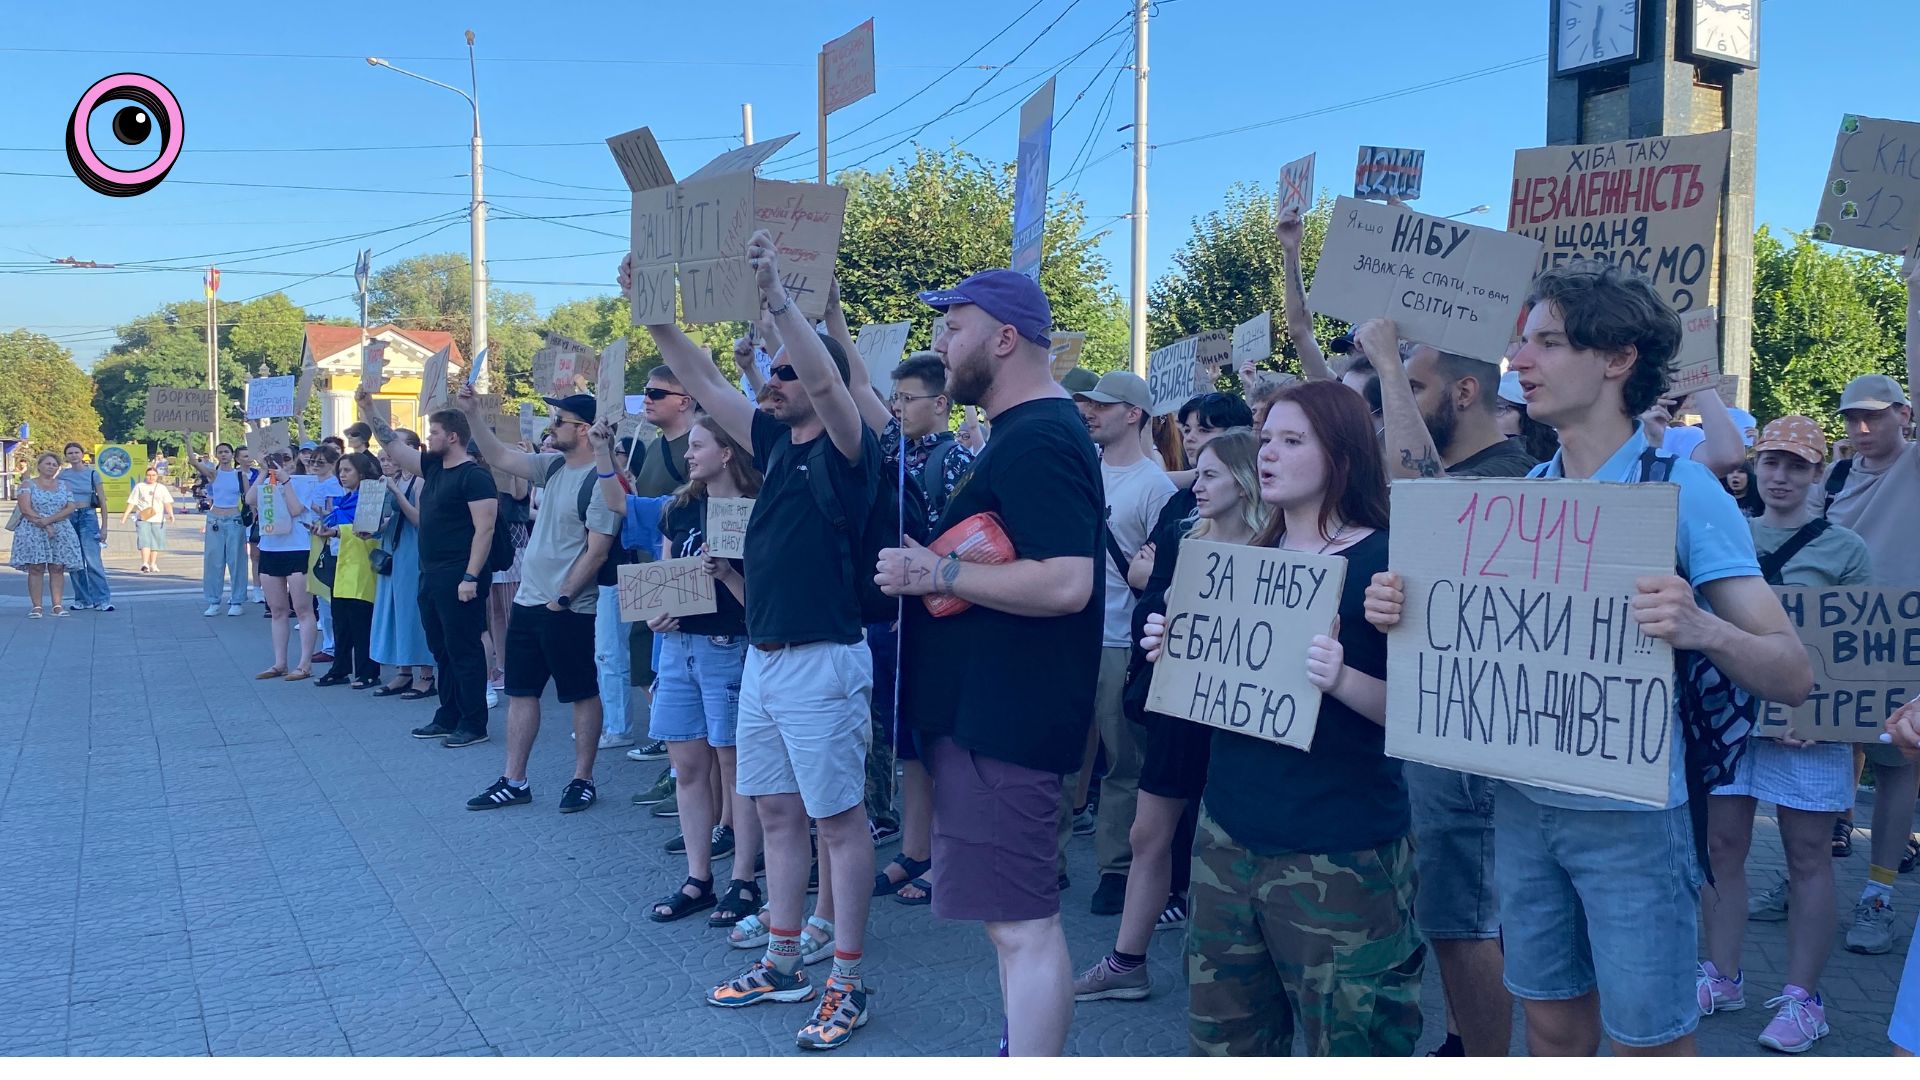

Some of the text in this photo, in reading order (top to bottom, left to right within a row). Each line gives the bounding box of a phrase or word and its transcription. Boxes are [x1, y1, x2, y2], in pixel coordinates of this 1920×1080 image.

[1566, 139, 1671, 173] ХІБА ТАКУ
[1509, 163, 1704, 229] НЕЗАЛЕЖНІСТЬ
[1391, 214, 1470, 259] НАБУ
[1554, 216, 1648, 251] ЩОДНЯ
[1401, 290, 1478, 323] СВІТИТЬ
[1488, 290, 1509, 304] ВАМ
[1151, 341, 1197, 374] КОРУПЦІЯ
[722, 535, 741, 552] НАБУ
[1458, 493, 1600, 592] 12414
[1199, 552, 1327, 610] ЗА НАБУ
[1427, 580, 1572, 656] СКАЖИ
[1820, 591, 1920, 628] БУЛО
[1168, 613, 1272, 671] ЄБАЛО
[1833, 628, 1920, 665] ВЖЕ
[1189, 672, 1295, 737] НАБ'Ю
[1417, 652, 1668, 764] НАКЛАДИВЕТО
